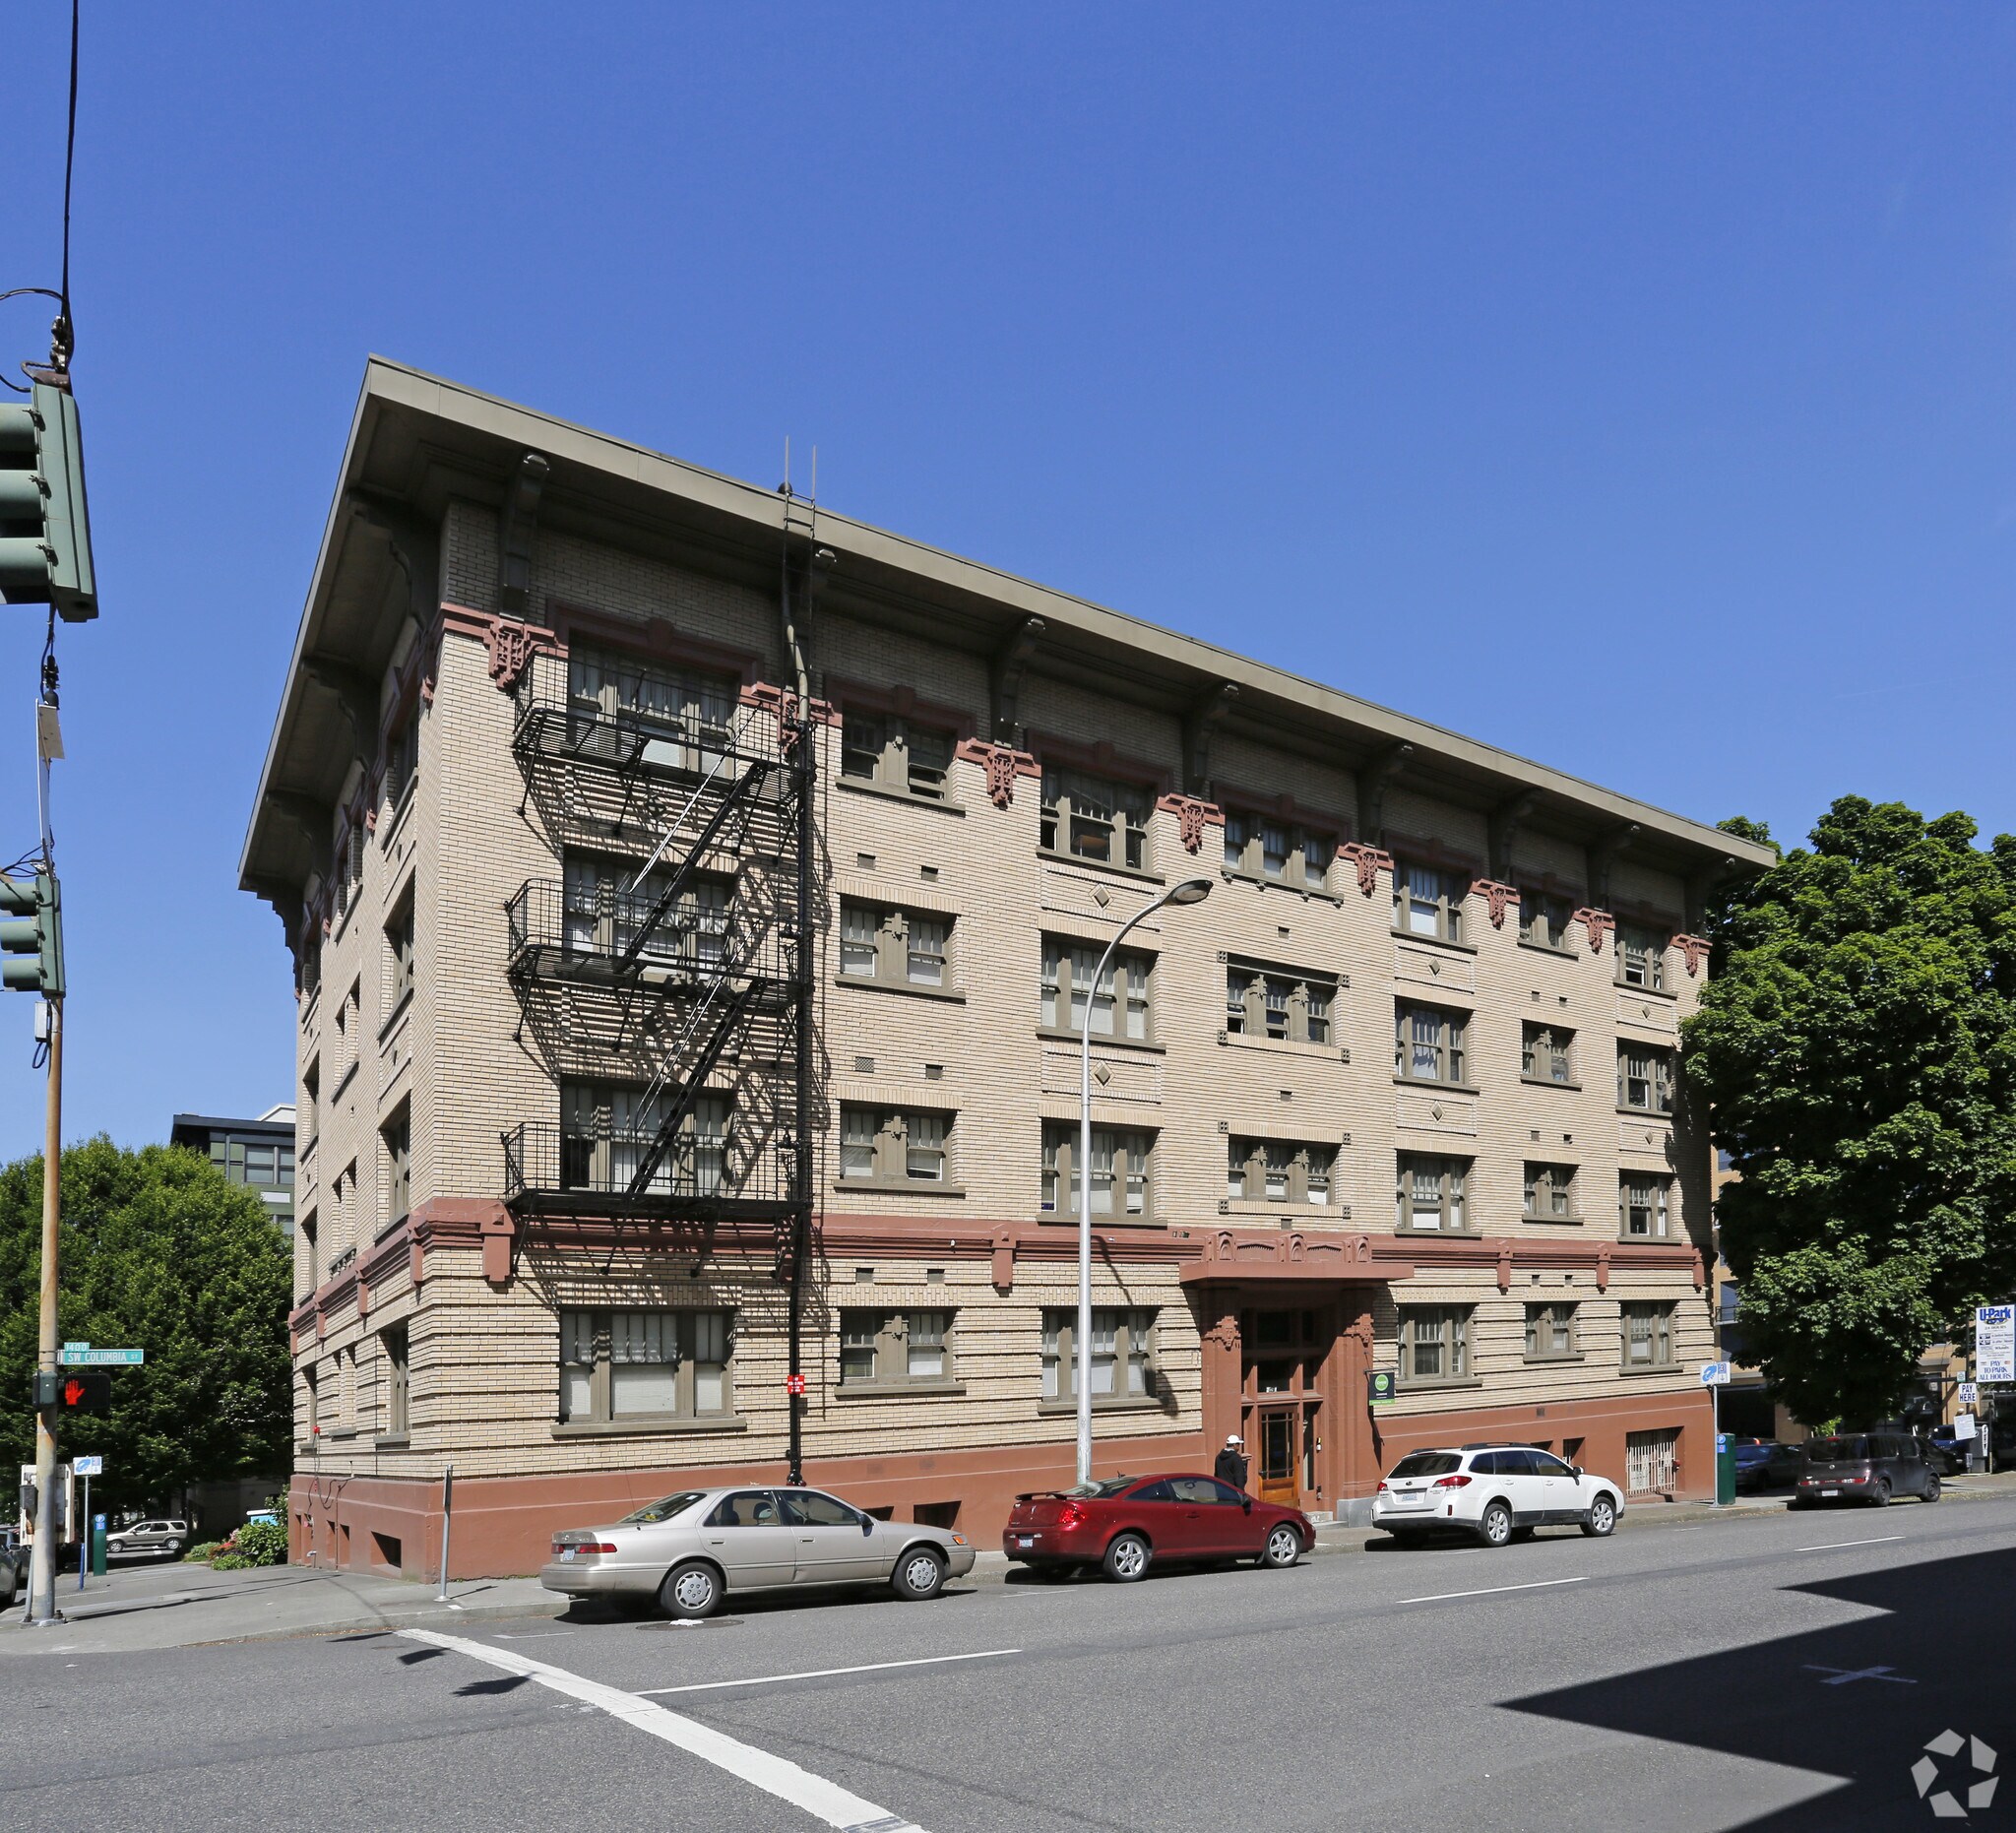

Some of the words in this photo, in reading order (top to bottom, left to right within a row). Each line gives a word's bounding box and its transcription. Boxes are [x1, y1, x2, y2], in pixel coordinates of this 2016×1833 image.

[1980, 1306, 2011, 1321] U-Park
[68, 1353, 81, 1362] SW
[85, 1352, 127, 1362] COLUMBIA
[1960, 1393, 1976, 1402] HERE
